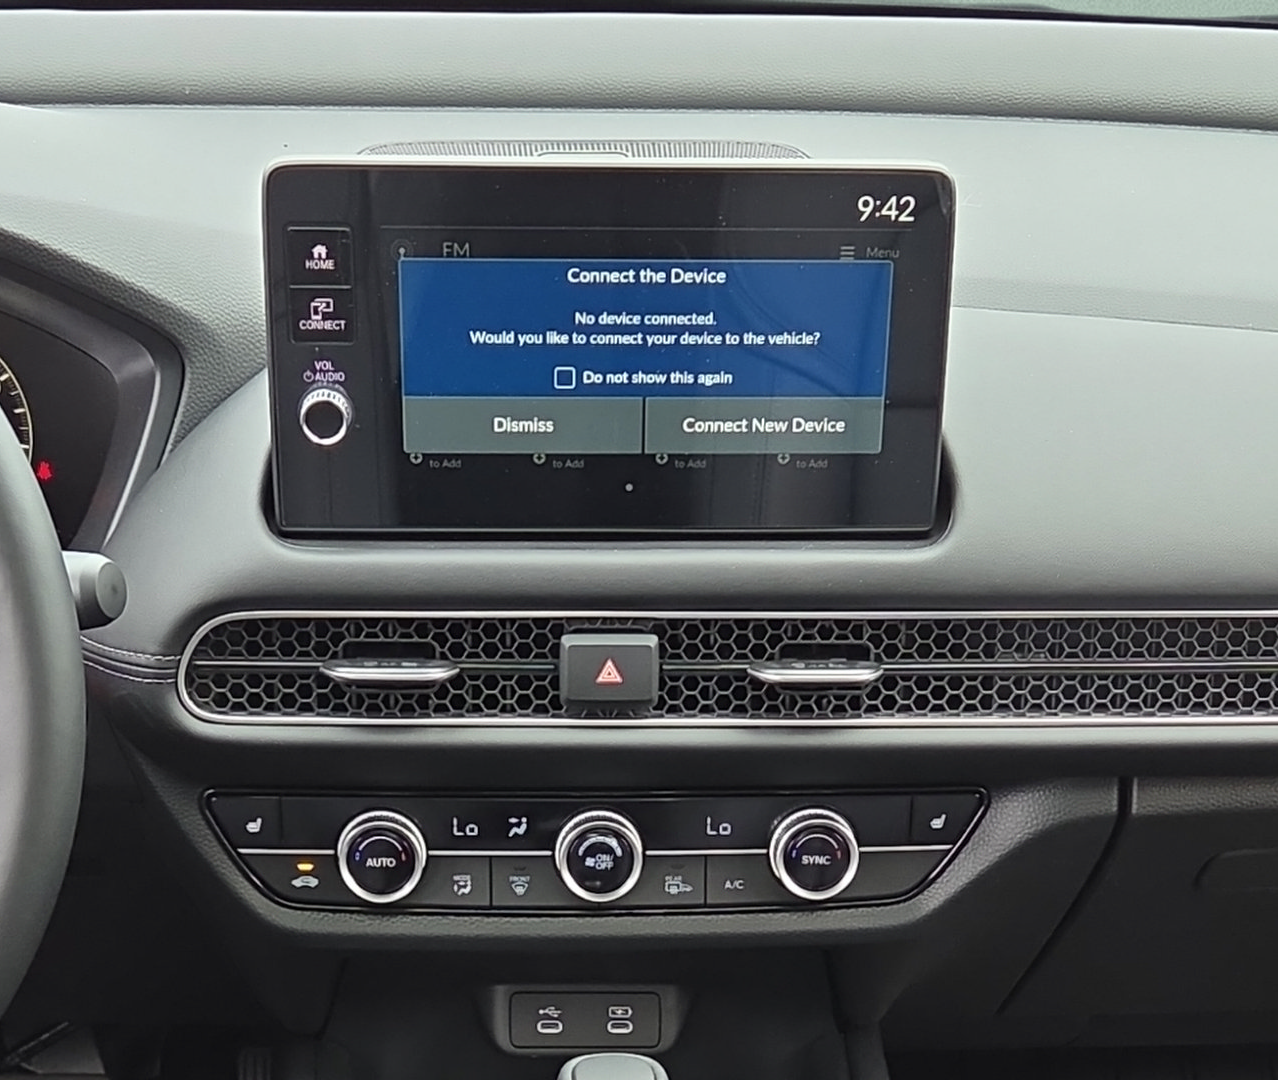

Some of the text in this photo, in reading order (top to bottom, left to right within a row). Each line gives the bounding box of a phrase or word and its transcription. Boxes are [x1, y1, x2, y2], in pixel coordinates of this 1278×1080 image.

[857, 195, 916, 222] 9:42
[442, 242, 470, 257] FM
[865, 247, 900, 258] Menu
[305, 259, 335, 270] HOME
[567, 268, 727, 284] Connect the Device
[575, 312, 717, 325] No device connected.
[299, 320, 346, 330] CONNECT
[469, 331, 821, 347] Would you like to connect your device to the vehicle?
[314, 361, 335, 370] VOL
[315, 372, 345, 381] AUDIO
[583, 371, 733, 386] Do not show this again
[493, 417, 555, 433] Dismiss
[682, 417, 846, 433] Connect New Device
[429, 459, 462, 469] to Add
[552, 459, 584, 469] to Add
[674, 459, 706, 469] to Add
[796, 459, 828, 469] to Add
[365, 858, 397, 868] AUTO
[596, 853, 614, 863] ON/
[801, 855, 832, 865] SYNC
[596, 861, 614, 871] OFF
[724, 879, 745, 889] A/C
